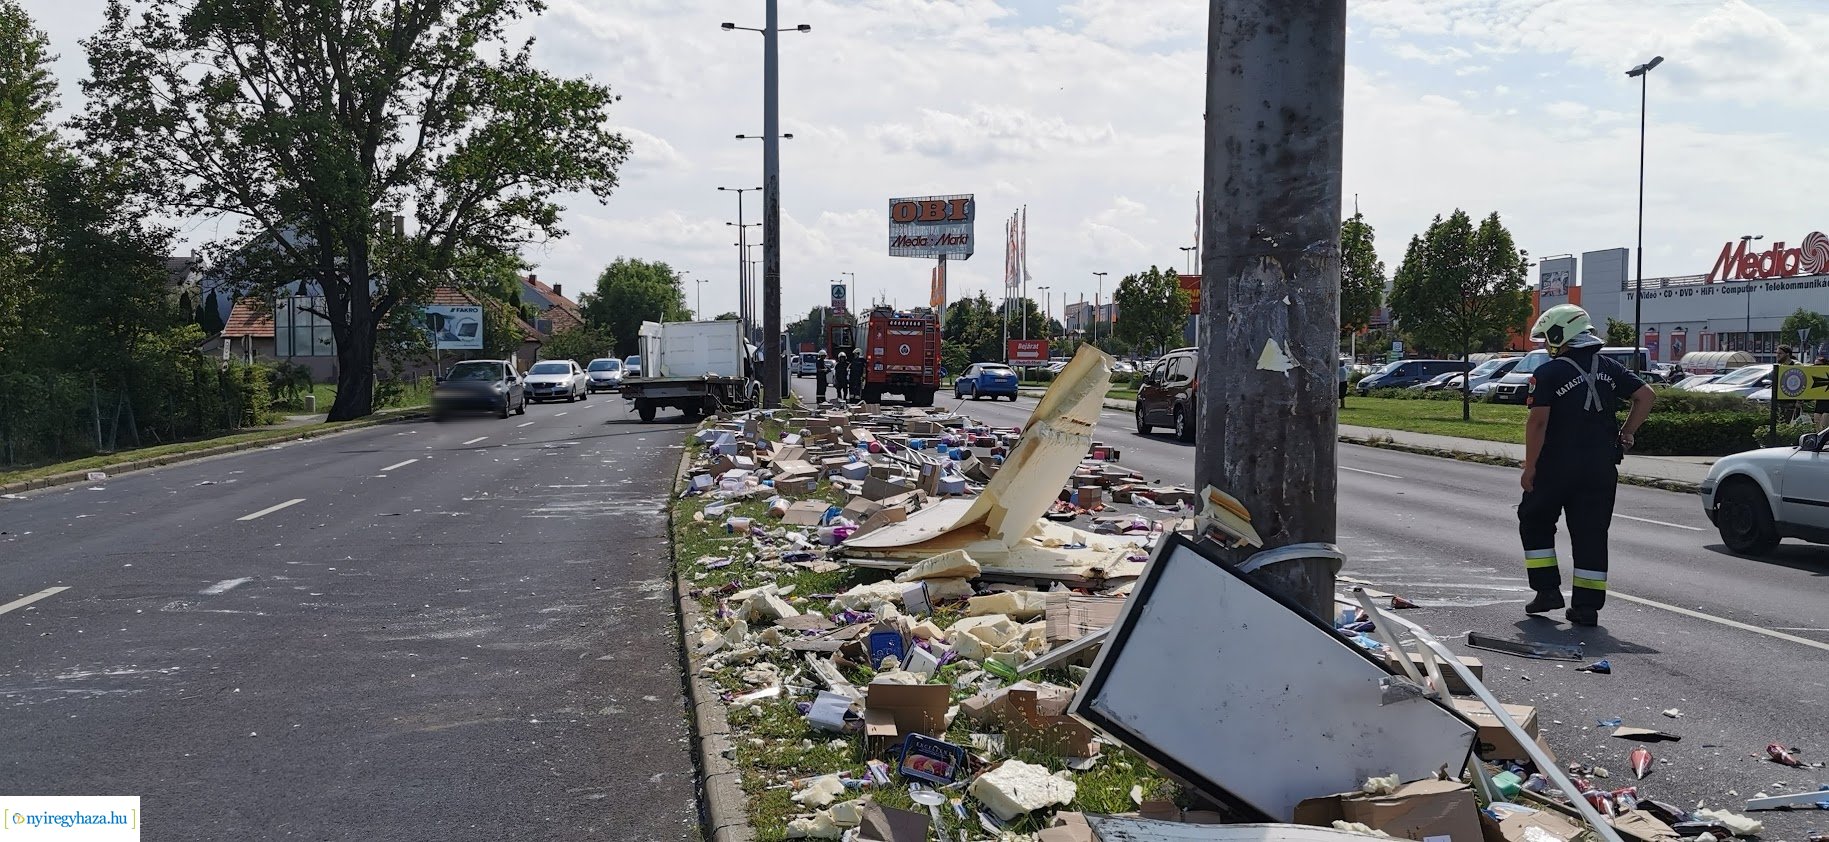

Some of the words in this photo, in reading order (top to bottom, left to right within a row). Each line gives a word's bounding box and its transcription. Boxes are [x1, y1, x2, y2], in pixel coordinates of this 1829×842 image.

[892, 199, 969, 222] OBI
[891, 234, 929, 248] Media
[934, 233, 969, 247] Markt
[1706, 240, 1801, 284] Media
[1663, 289, 1673, 298] CD
[1679, 288, 1694, 297] DVD
[1721, 284, 1757, 295] Computer
